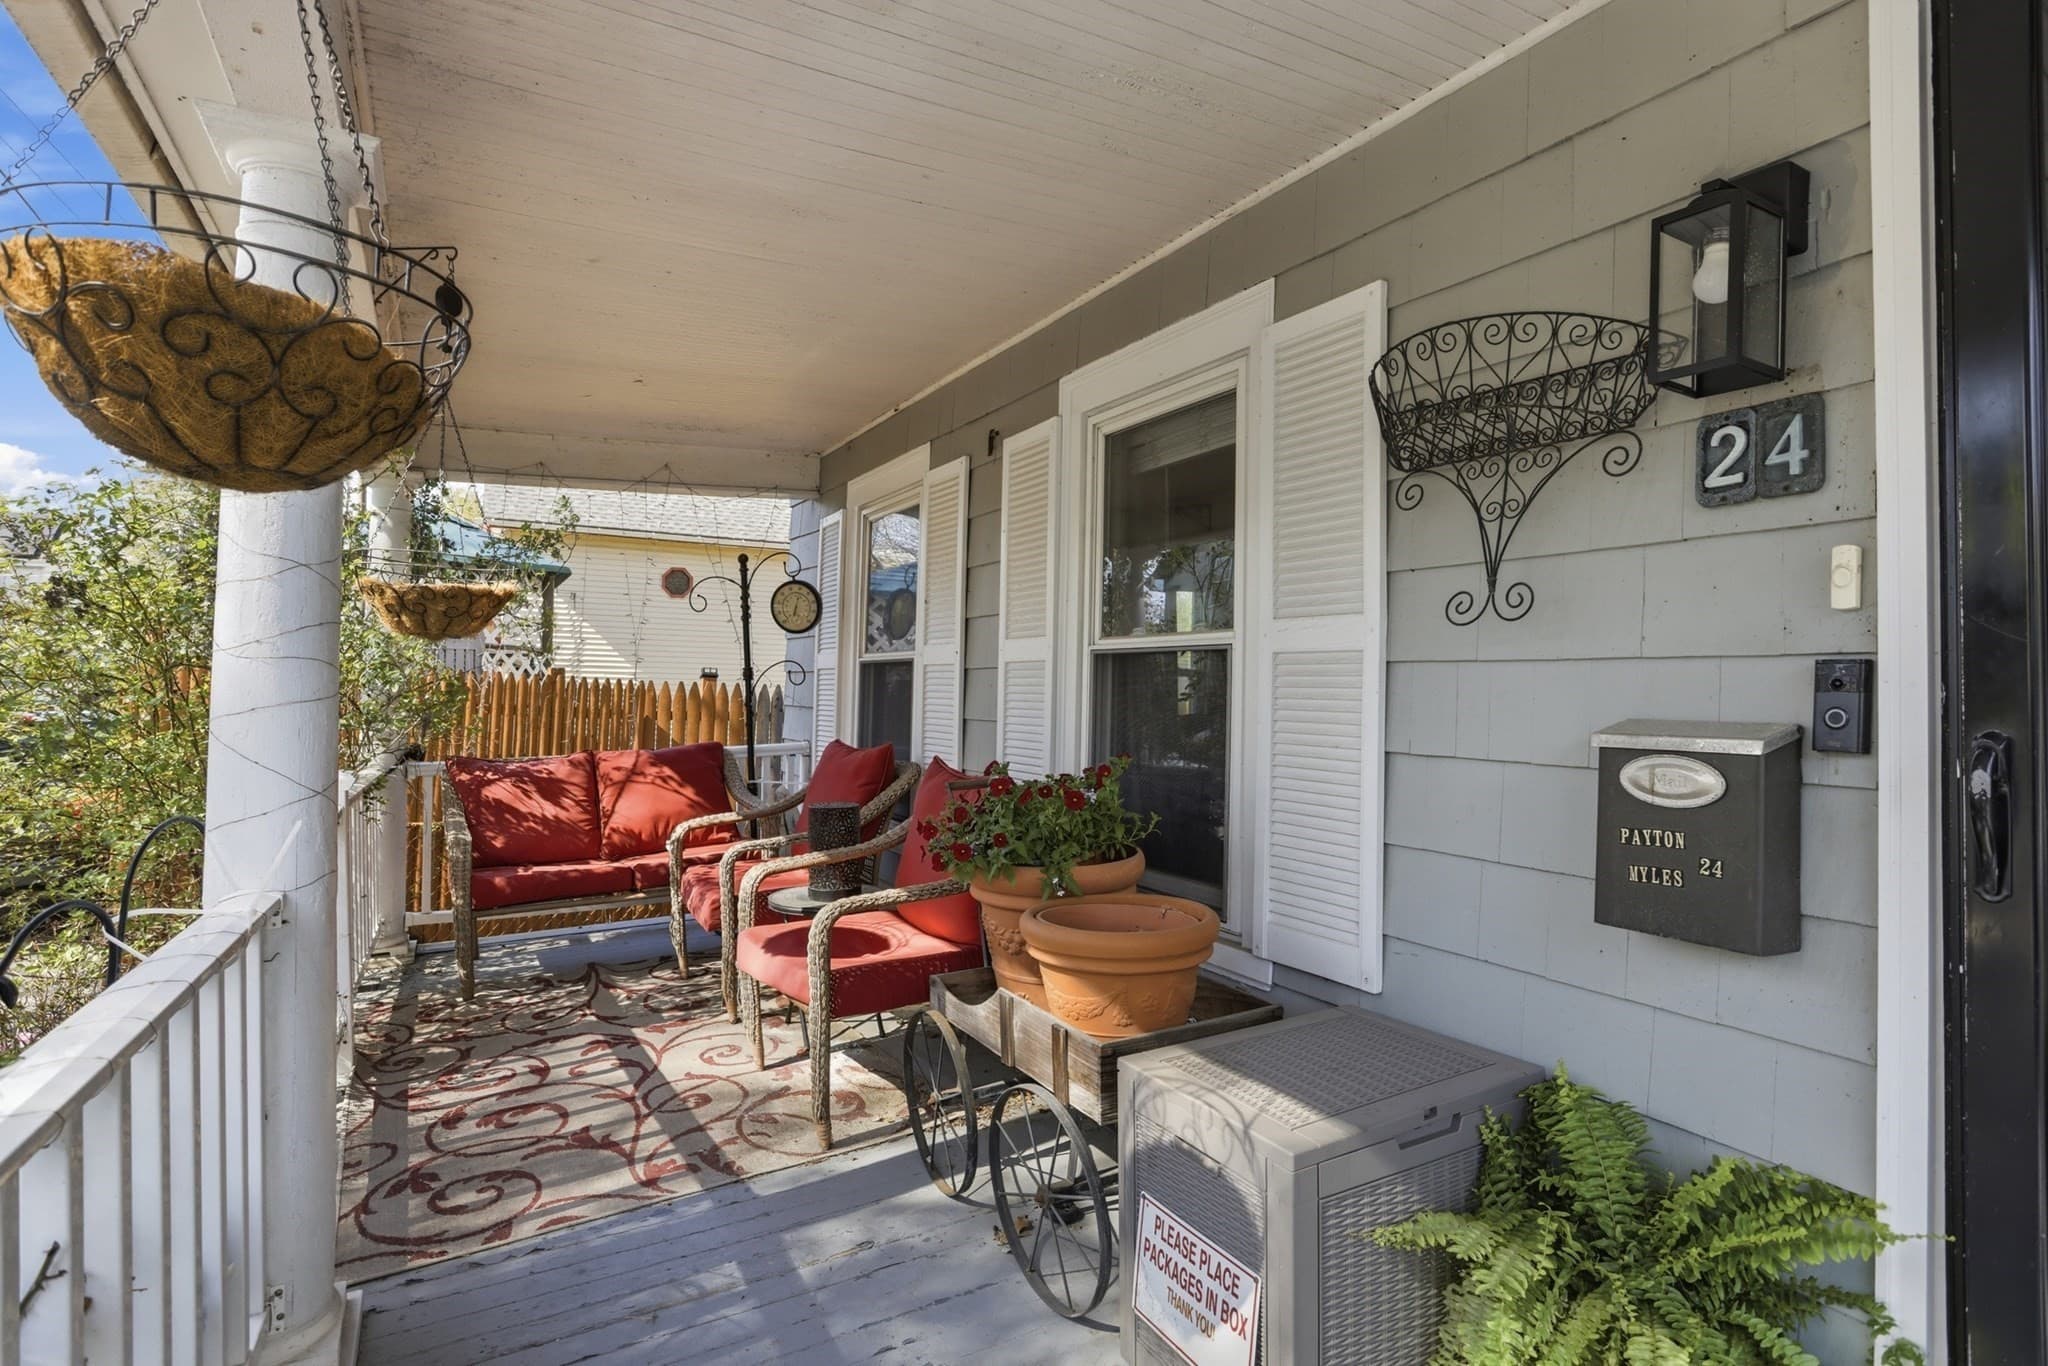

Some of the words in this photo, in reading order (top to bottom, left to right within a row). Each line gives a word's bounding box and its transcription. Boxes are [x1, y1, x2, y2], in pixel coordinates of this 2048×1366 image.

[1704, 413, 1810, 488] 24
[1620, 828, 1685, 849] PAYTON
[1629, 865, 1683, 887] MYLES
[1700, 858, 1723, 878] 24
[1154, 1214, 1197, 1266] PLEASE
[1199, 1248, 1240, 1300] PLACE
[1143, 1237, 1203, 1303] PACKAGES
[1205, 1286, 1218, 1316] IN
[1220, 1299, 1248, 1341] BOX
[1167, 1286, 1194, 1323] THANK
[1195, 1310, 1216, 1341] YOU!
